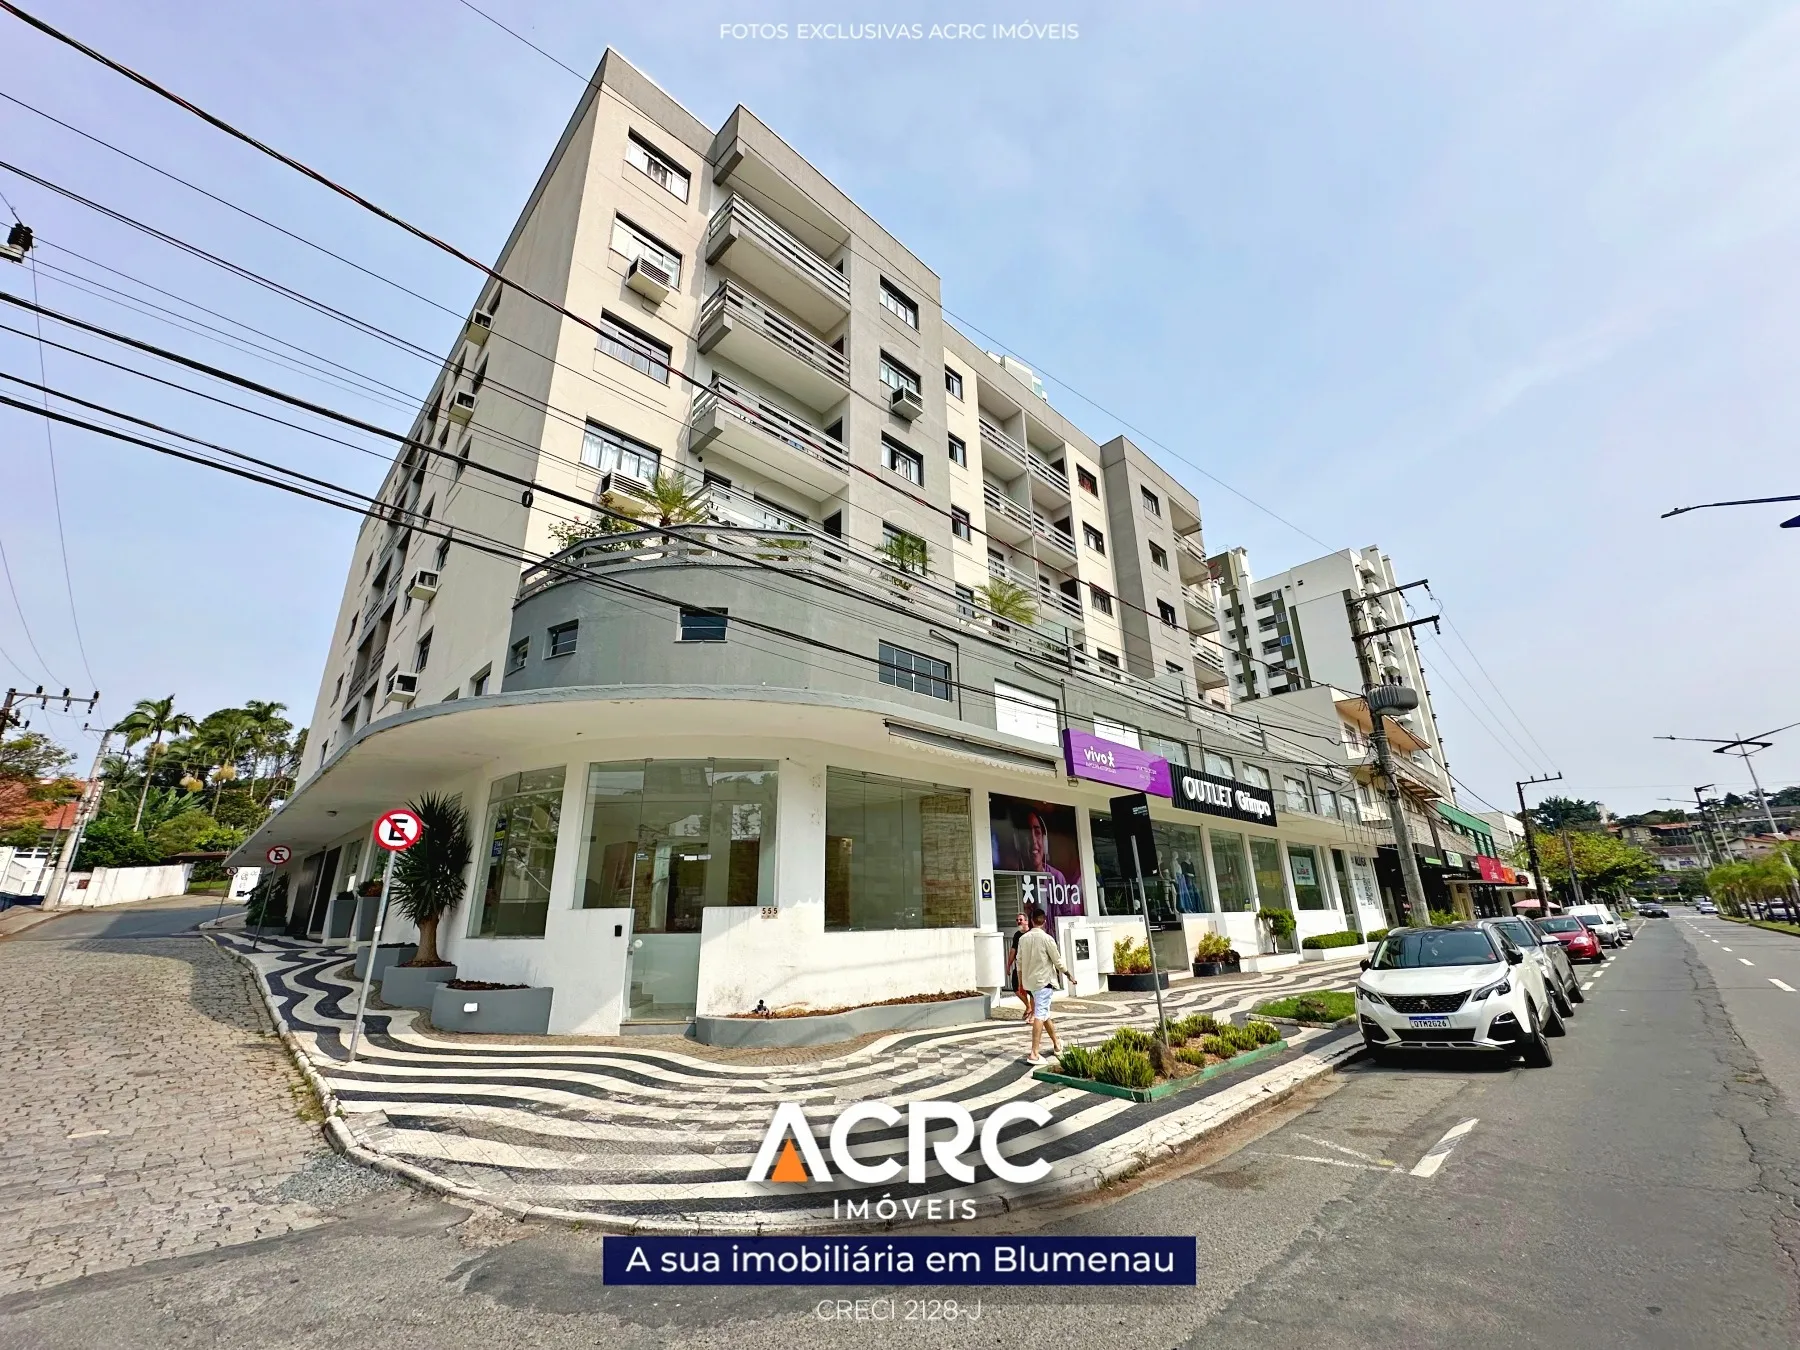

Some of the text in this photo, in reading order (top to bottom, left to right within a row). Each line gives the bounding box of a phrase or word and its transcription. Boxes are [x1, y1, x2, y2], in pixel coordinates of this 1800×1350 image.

[1084, 746, 1107, 765] vivo
[1182, 776, 1232, 808] OUTLET
[389, 819, 408, 841] E
[1036, 875, 1081, 905] Fibra
[762, 907, 778, 915] 555
